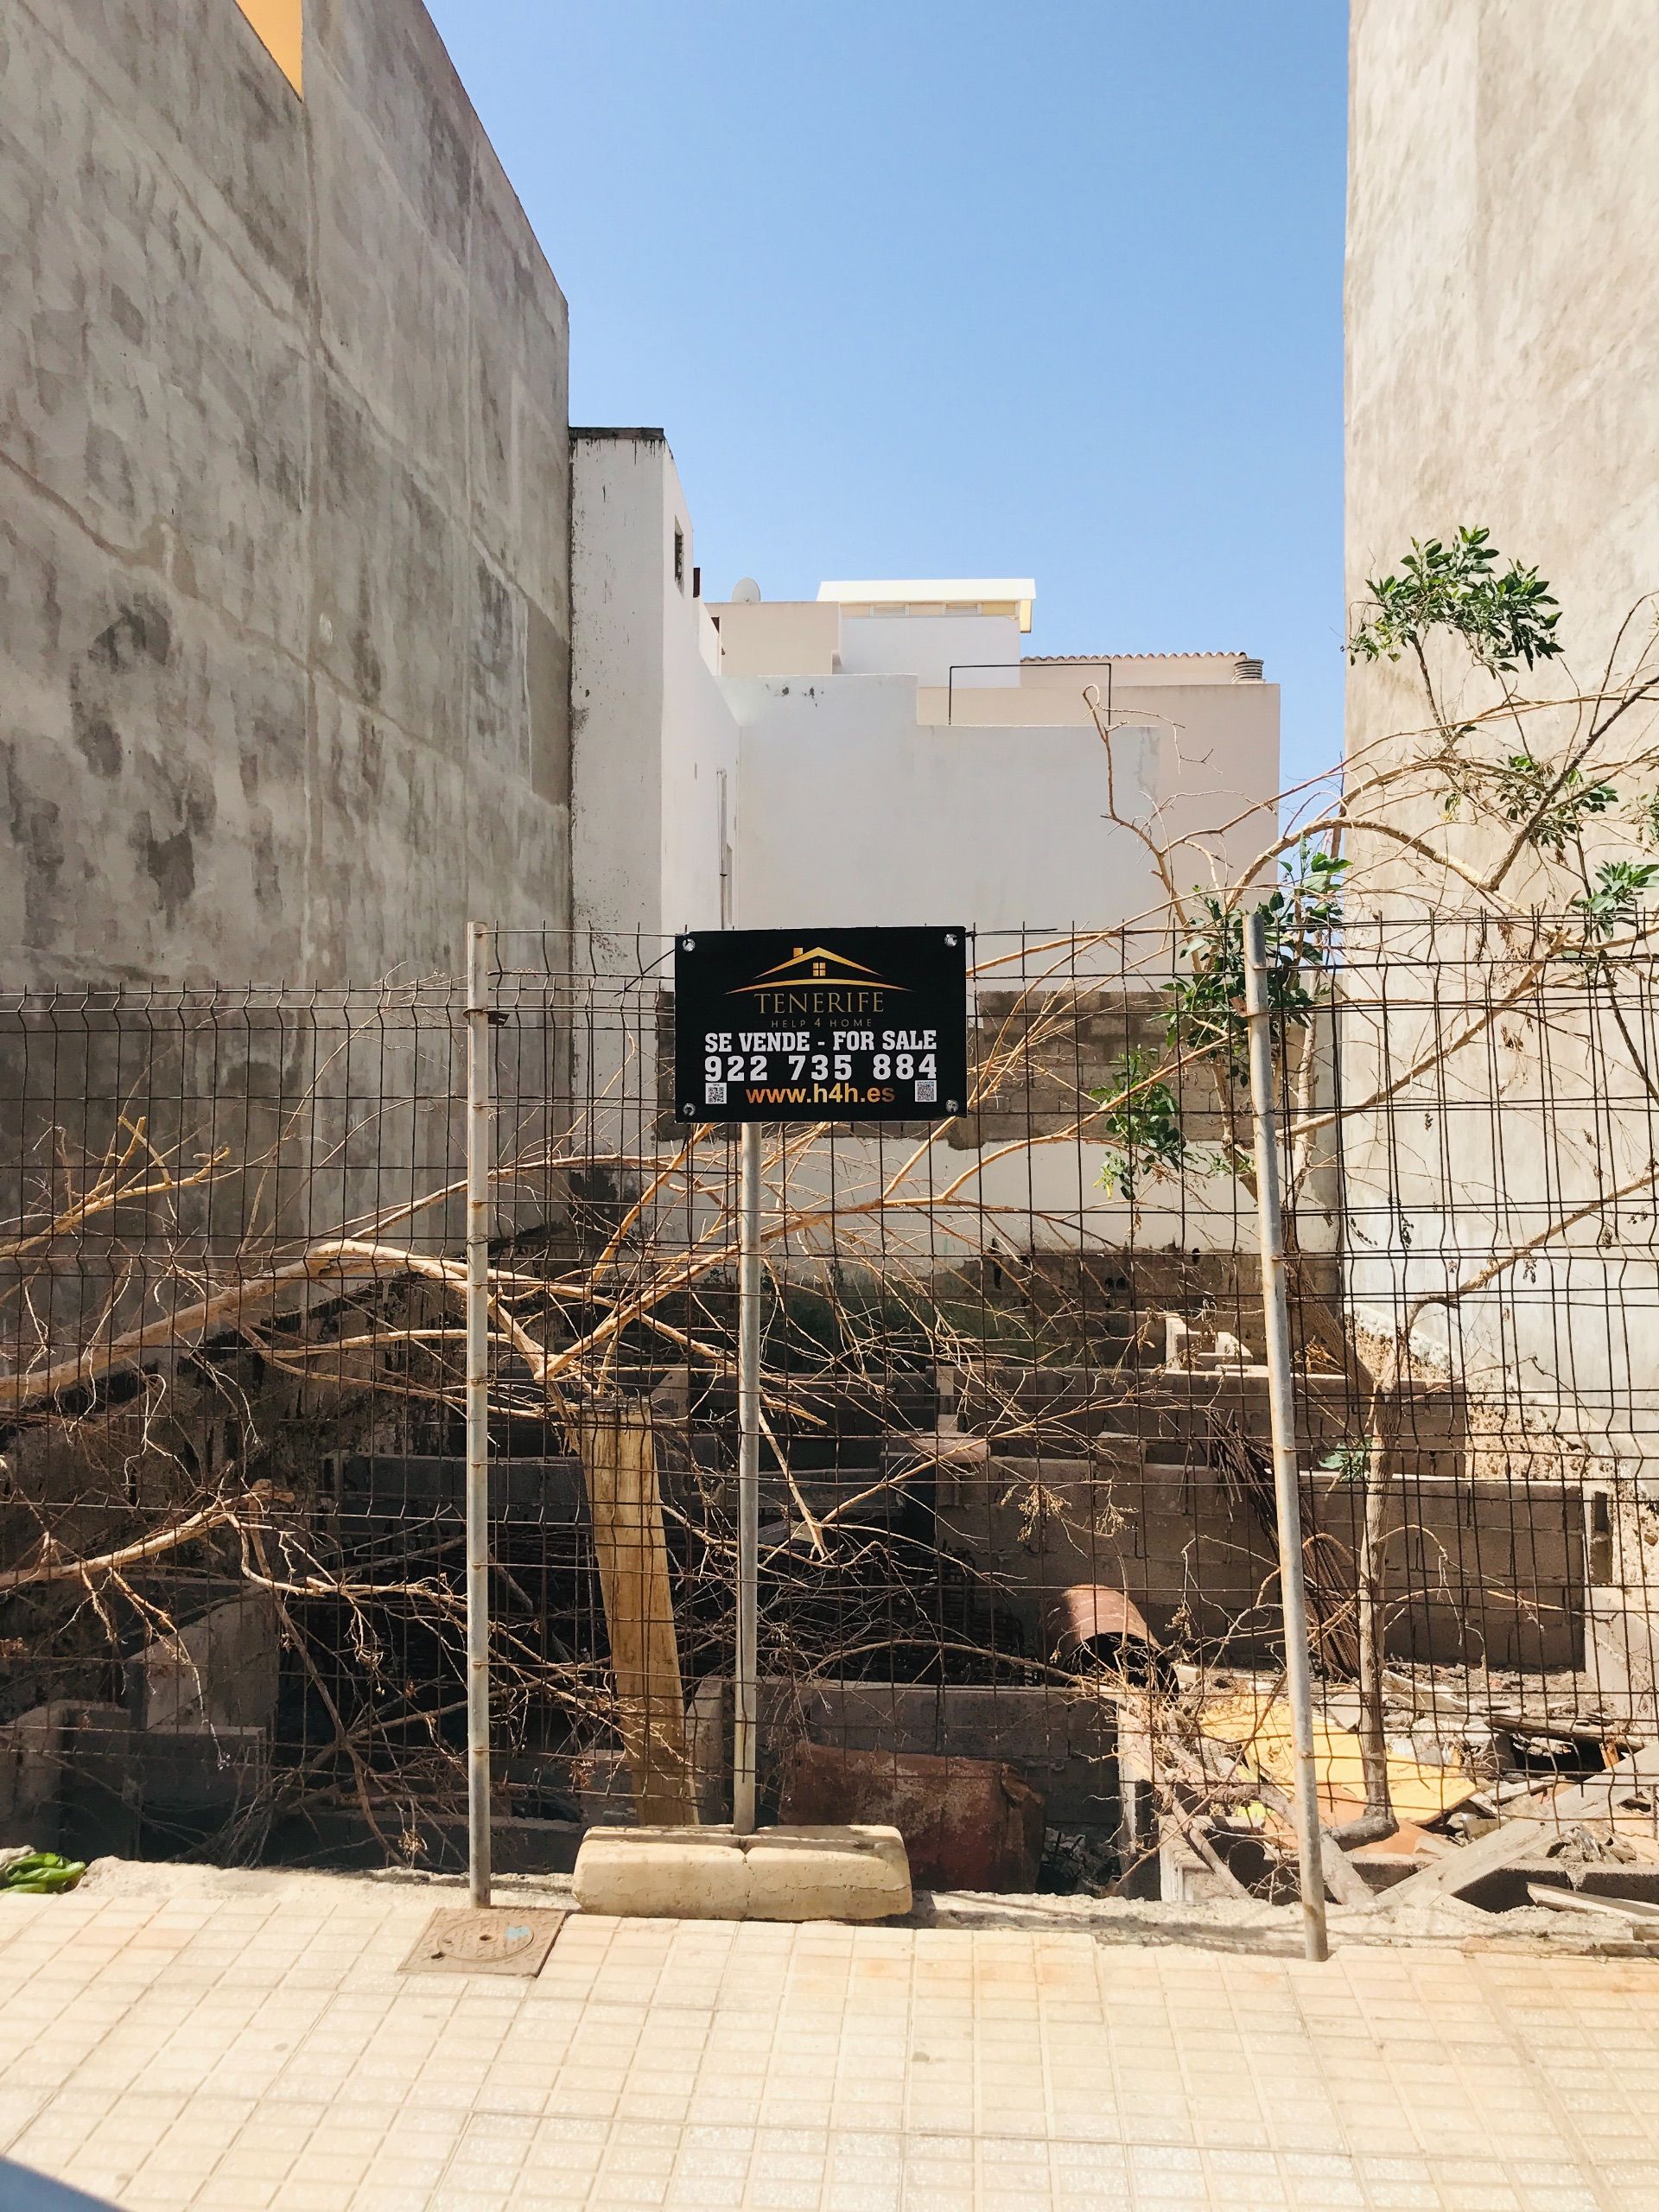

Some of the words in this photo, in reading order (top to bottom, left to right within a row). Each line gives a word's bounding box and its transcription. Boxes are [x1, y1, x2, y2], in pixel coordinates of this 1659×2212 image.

[753, 992, 885, 1014] TENERIFE
[772, 1020, 806, 1028] HELP
[814, 1018, 822, 1028] 4
[830, 1018, 873, 1027] HOME
[704, 1033, 733, 1052] SE
[739, 1031, 810, 1052] VENDE
[833, 1031, 874, 1051] FOR
[881, 1029, 937, 1051] SALE
[704, 1055, 768, 1082] 922
[788, 1054, 852, 1081] 735
[873, 1053, 937, 1079] 884
[746, 1083, 895, 1103] www.h4h.es
